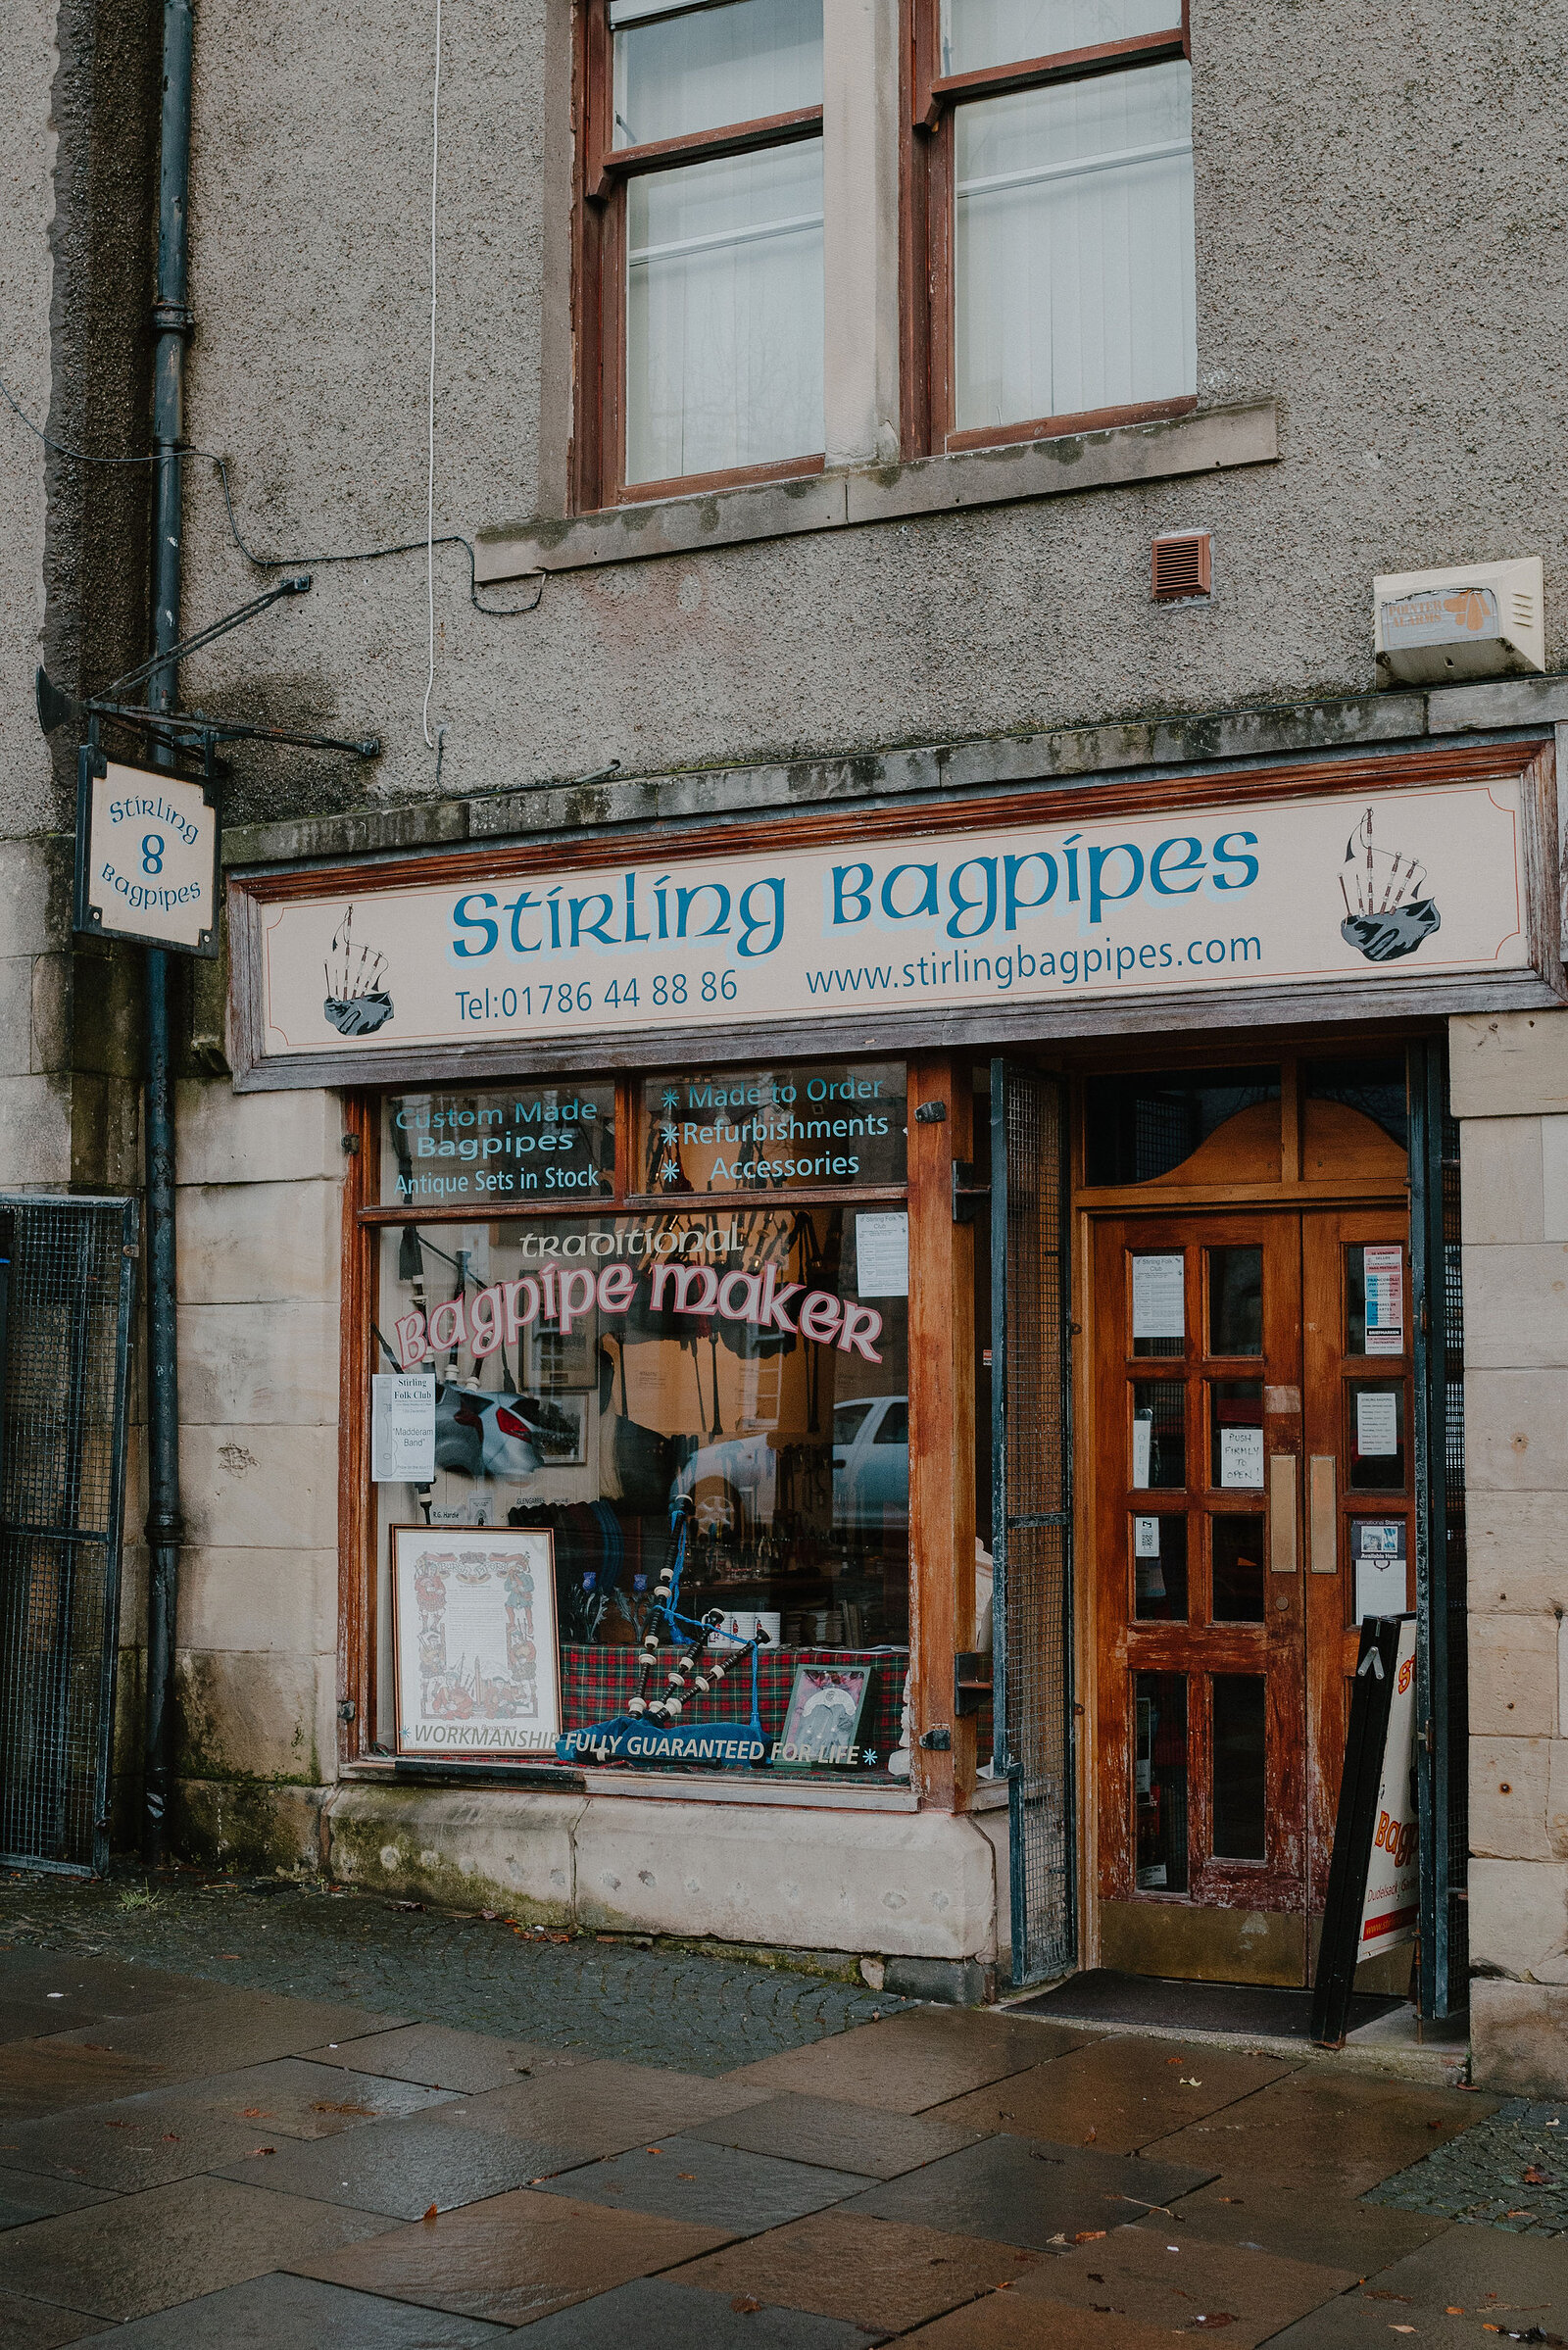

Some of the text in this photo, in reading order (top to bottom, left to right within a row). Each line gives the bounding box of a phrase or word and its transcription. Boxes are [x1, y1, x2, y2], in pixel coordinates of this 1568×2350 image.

[1389, 600, 1442, 616] POINTER
[1394, 613, 1443, 627] ALARMS
[110, 795, 199, 845] Stirling
[142, 834, 165, 874] 8
[101, 862, 201, 911] Bagpipes
[452, 830, 1259, 958] Stirling Bagpipes
[806, 935, 1262, 995] www.stirlingbagpipes.com
[455, 968, 738, 1021] Tel:01786 44 88 86
[689, 1076, 883, 1107] Made to Order
[396, 1098, 598, 1130] Custom Made
[683, 1112, 889, 1145] Refurbishments
[417, 1131, 574, 1161] Bagpipes
[394, 1163, 599, 1198] Antique Sets in Stock
[710, 1151, 860, 1180] Accessories
[519, 1221, 744, 1257] traditional
[395, 1262, 638, 1370] Bagpipe
[394, 1391, 431, 1399] Folk Club
[398, 1378, 427, 1388] Stirling
[1225, 1445, 1260, 1456] FIRMLY
[1229, 1433, 1252, 1443] PUSH
[415, 1724, 860, 1765] WORKMANSHIP FULLY GUARANTEED FOR LIFE
